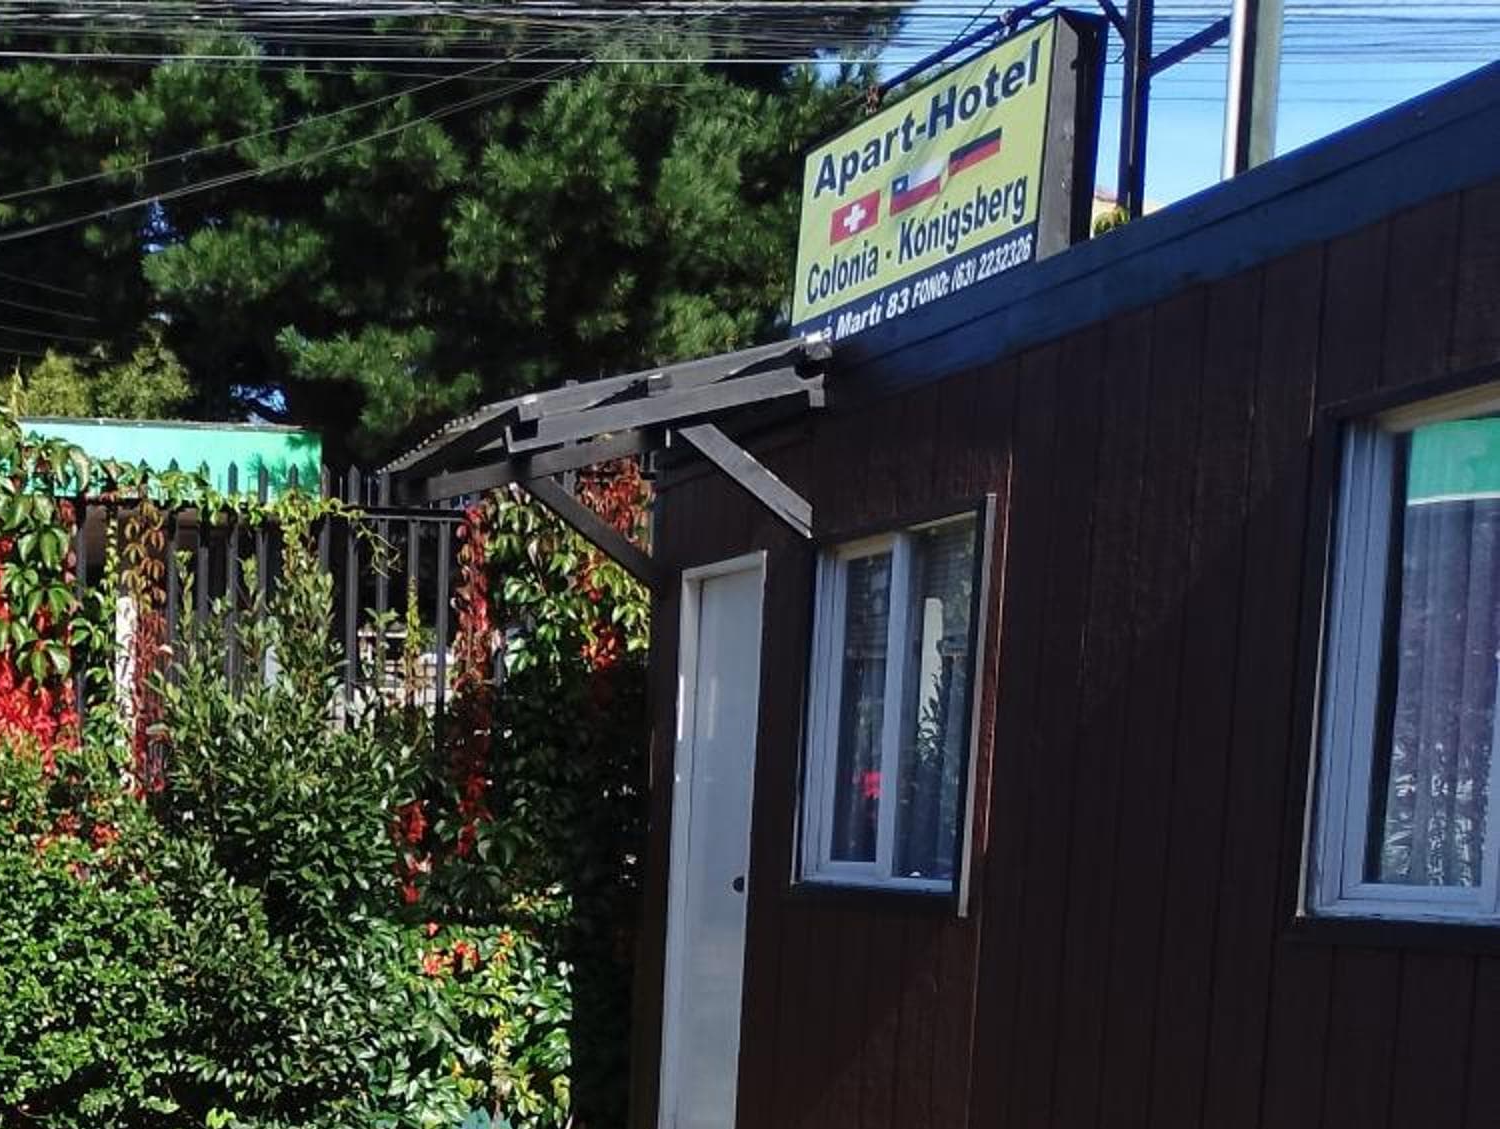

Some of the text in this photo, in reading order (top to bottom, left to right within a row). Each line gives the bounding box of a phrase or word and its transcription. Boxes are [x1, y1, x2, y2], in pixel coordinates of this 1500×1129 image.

[813, 37, 1041, 198] Apart-Hotel
[806, 240, 879, 304] Colonia
[899, 174, 1028, 265] Königsberg
[836, 292, 883, 341] Martí
[886, 293, 908, 316] 83
